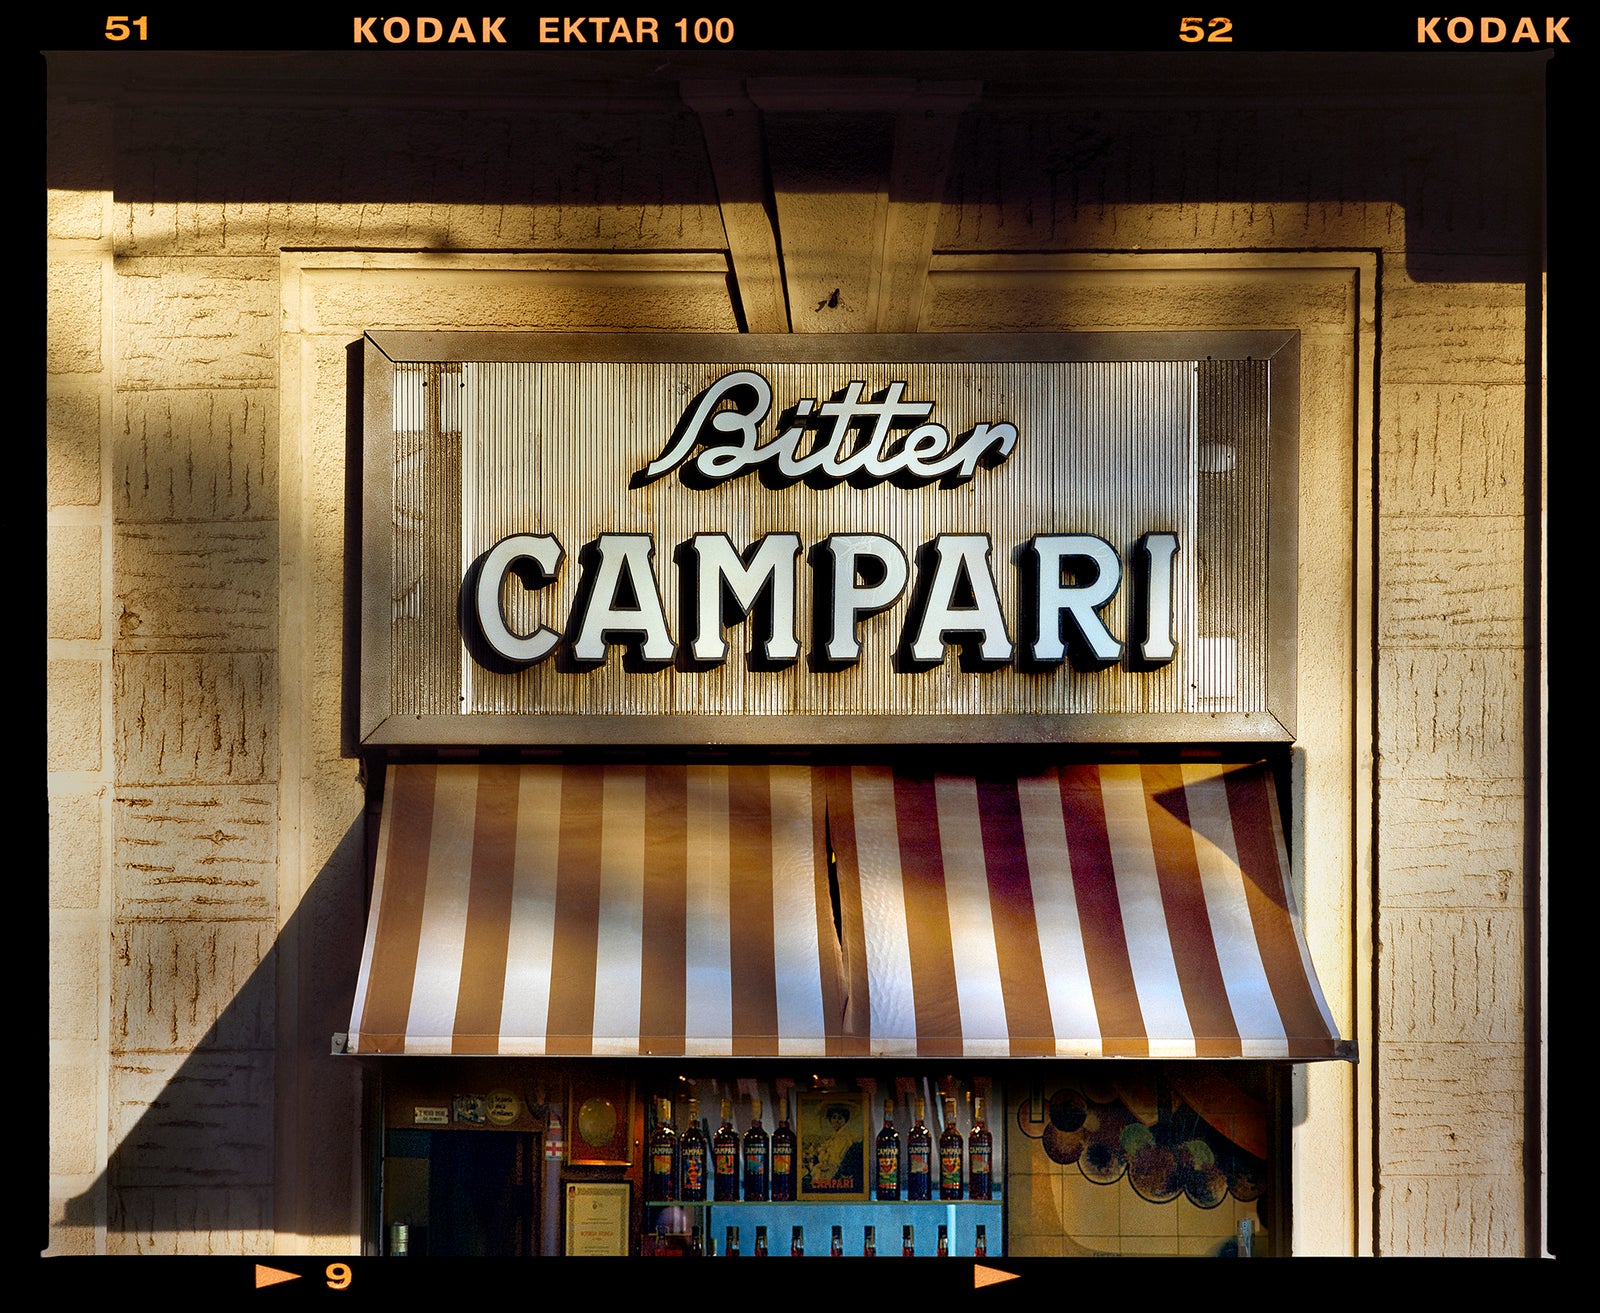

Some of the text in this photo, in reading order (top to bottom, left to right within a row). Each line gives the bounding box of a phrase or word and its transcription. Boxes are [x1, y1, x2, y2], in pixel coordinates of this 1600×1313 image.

[104, 16, 148, 42] 51
[353, 16, 735, 44] KODAK EKTAR 100
[1178, 17, 1234, 43] 52
[1417, 16, 1571, 44] KODAK
[636, 370, 1018, 488] Bitter
[466, 531, 1181, 670] CAMPARI
[325, 1262, 353, 1290] 9
